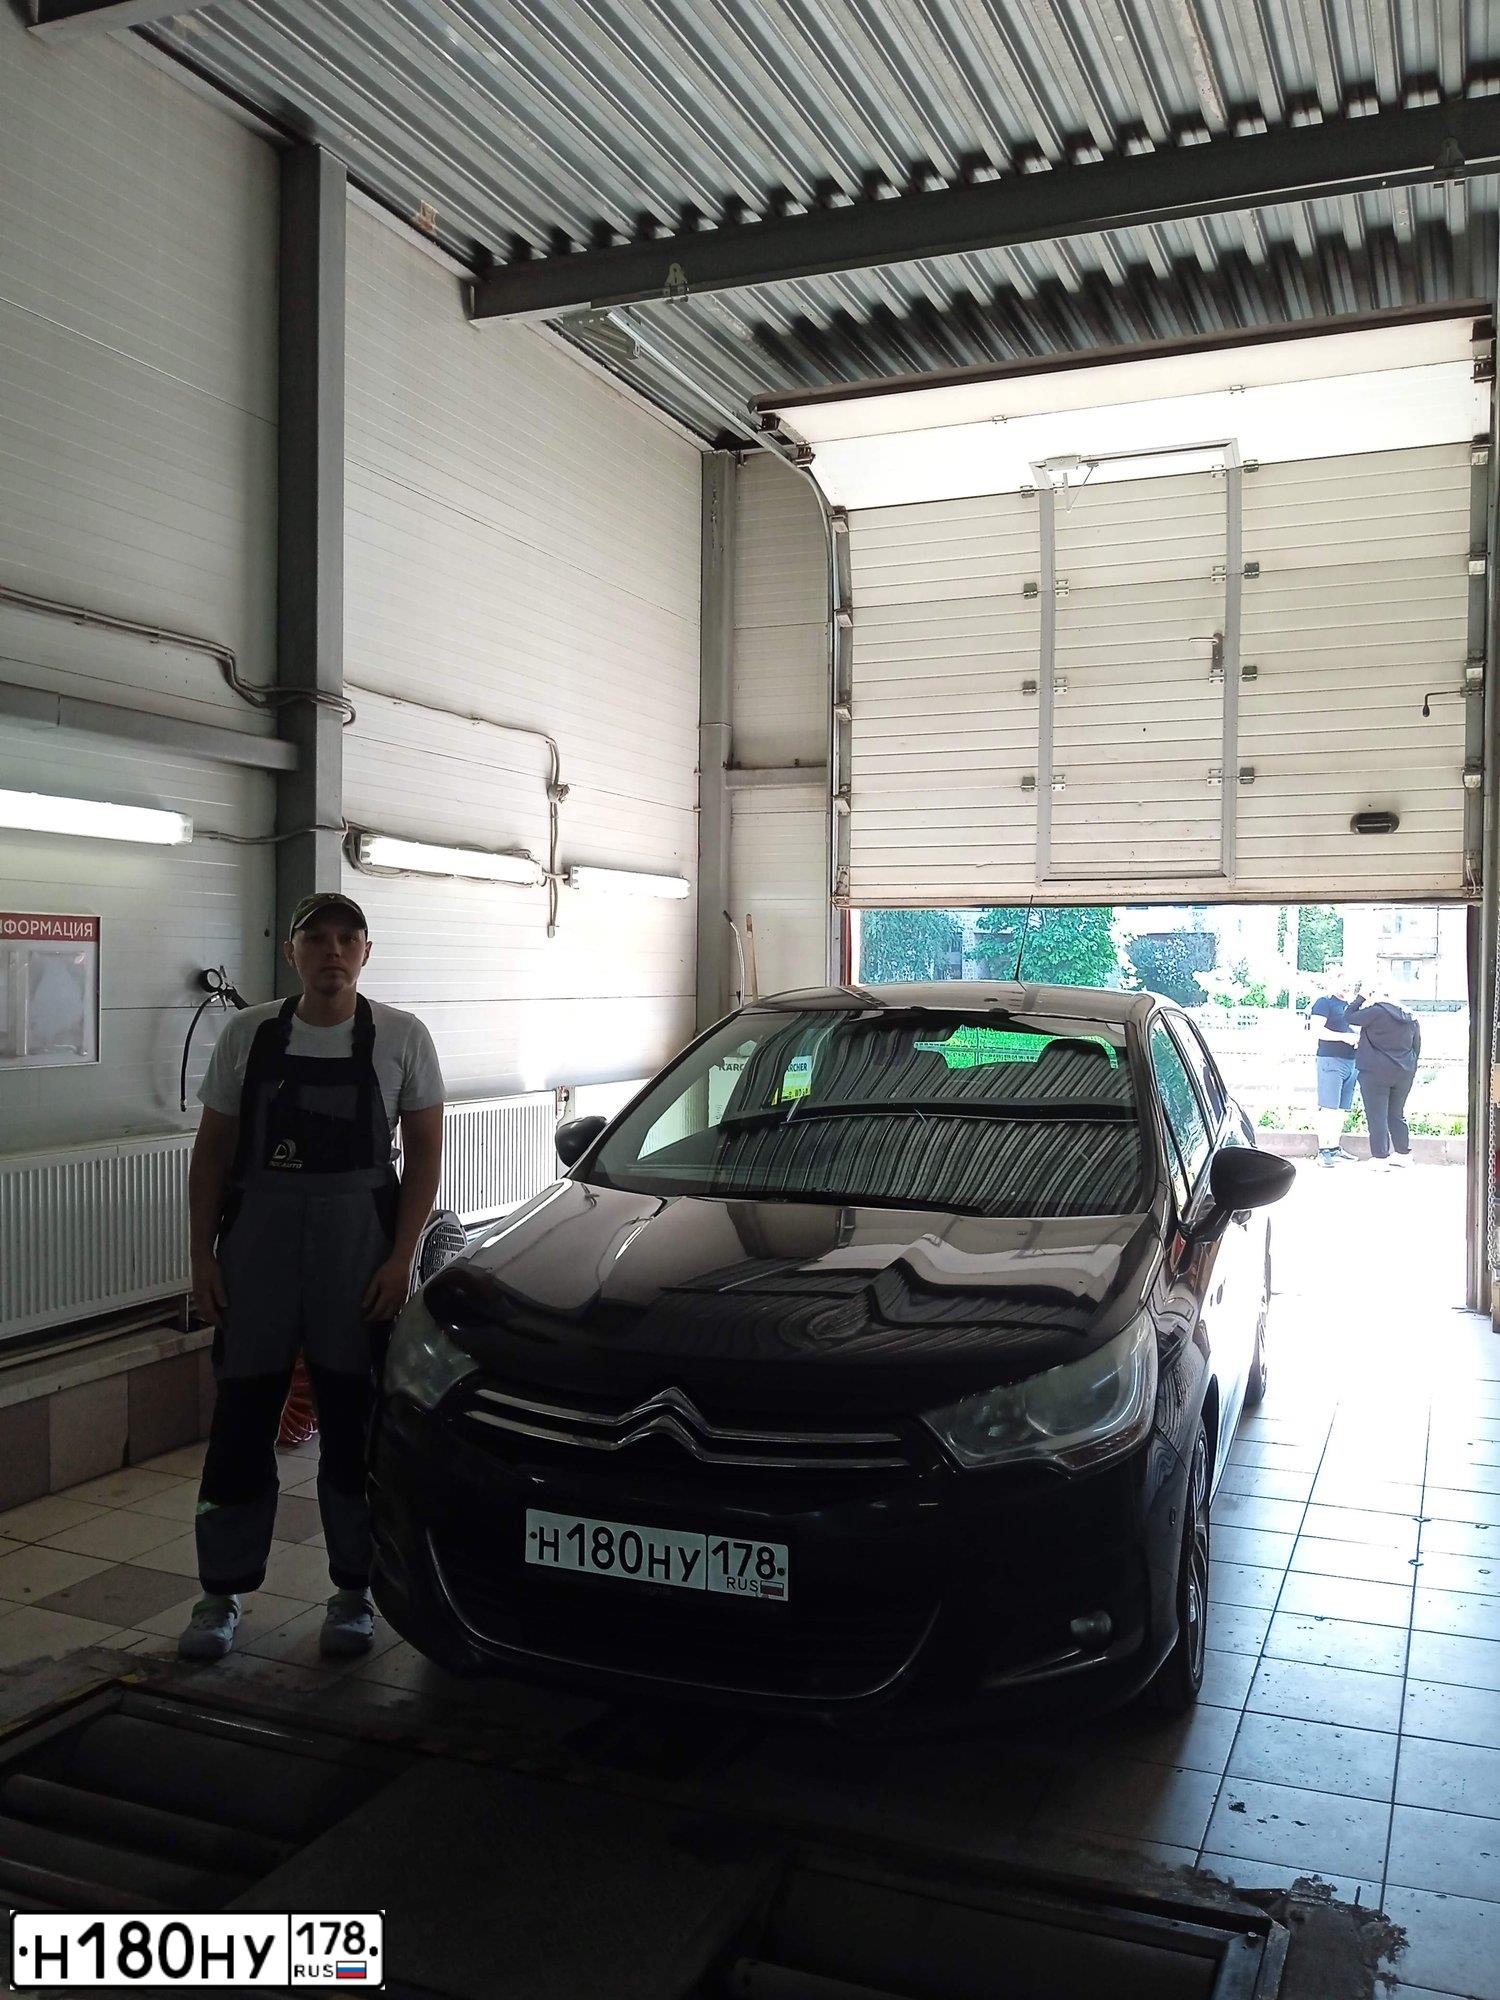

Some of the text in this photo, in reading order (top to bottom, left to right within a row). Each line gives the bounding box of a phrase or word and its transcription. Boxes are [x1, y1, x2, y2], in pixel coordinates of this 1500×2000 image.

[0, 919, 93, 938] ФОРМАЦИЯ
[788, 1062, 808, 1072] RCHER
[711, 1541, 776, 1580] 178
[726, 1576, 758, 1592] RUS
